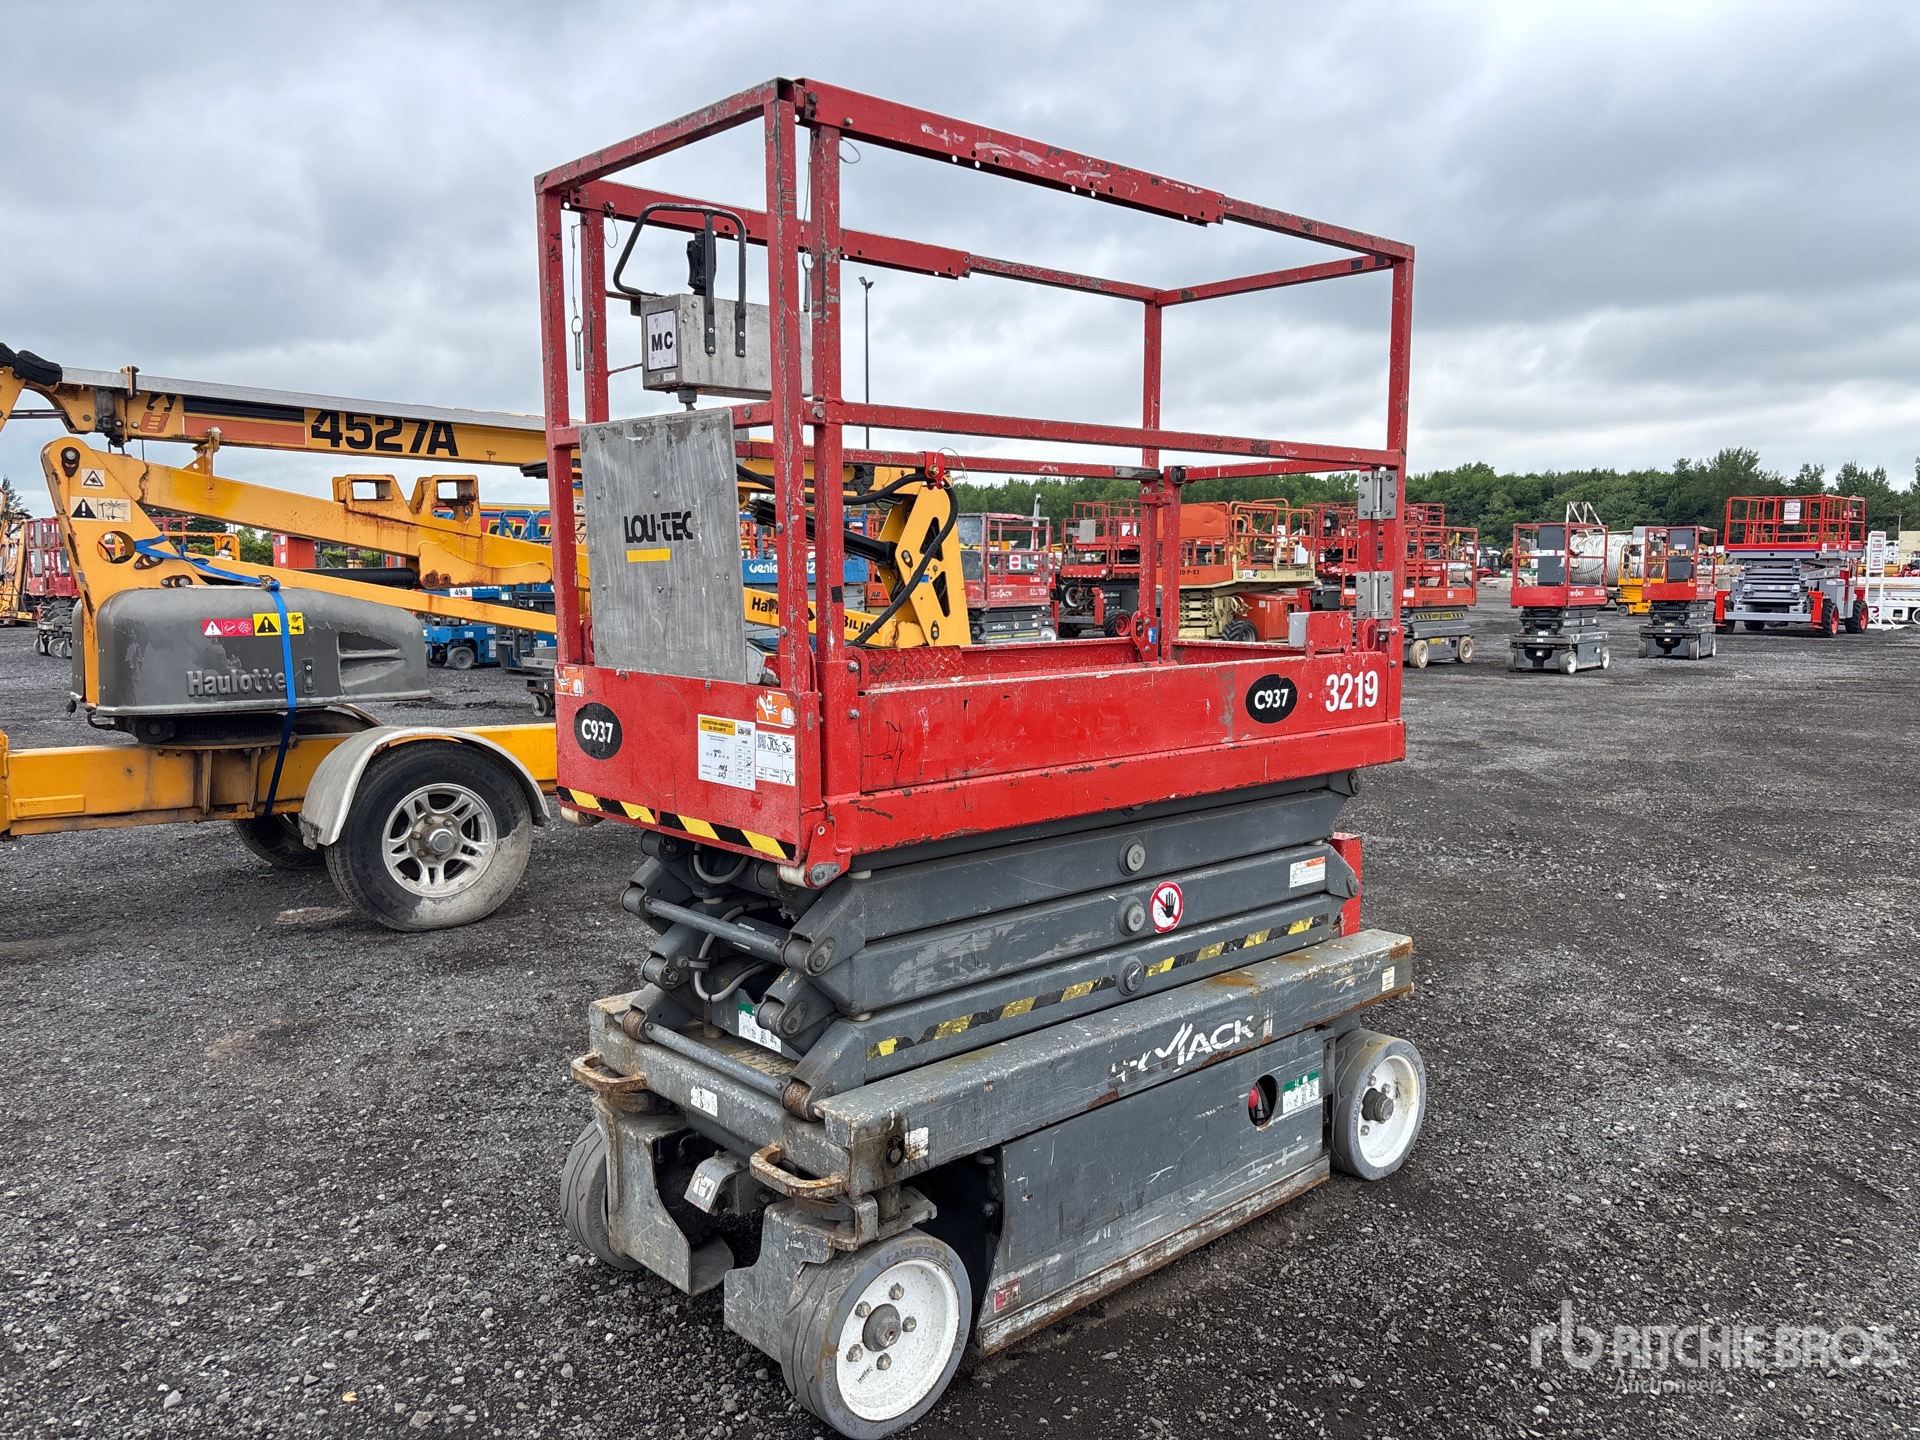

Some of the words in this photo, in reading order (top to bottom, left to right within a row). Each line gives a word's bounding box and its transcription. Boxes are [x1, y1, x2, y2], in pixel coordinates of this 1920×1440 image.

[651, 331, 673, 351] MC
[311, 410, 459, 457] 4527A
[623, 510, 694, 544] LOU-TEC
[454, 588, 468, 596] 498
[186, 668, 287, 696] Haulotte
[1325, 670, 1379, 712] 3219
[1254, 688, 1289, 710] C937
[581, 718, 614, 744] C937
